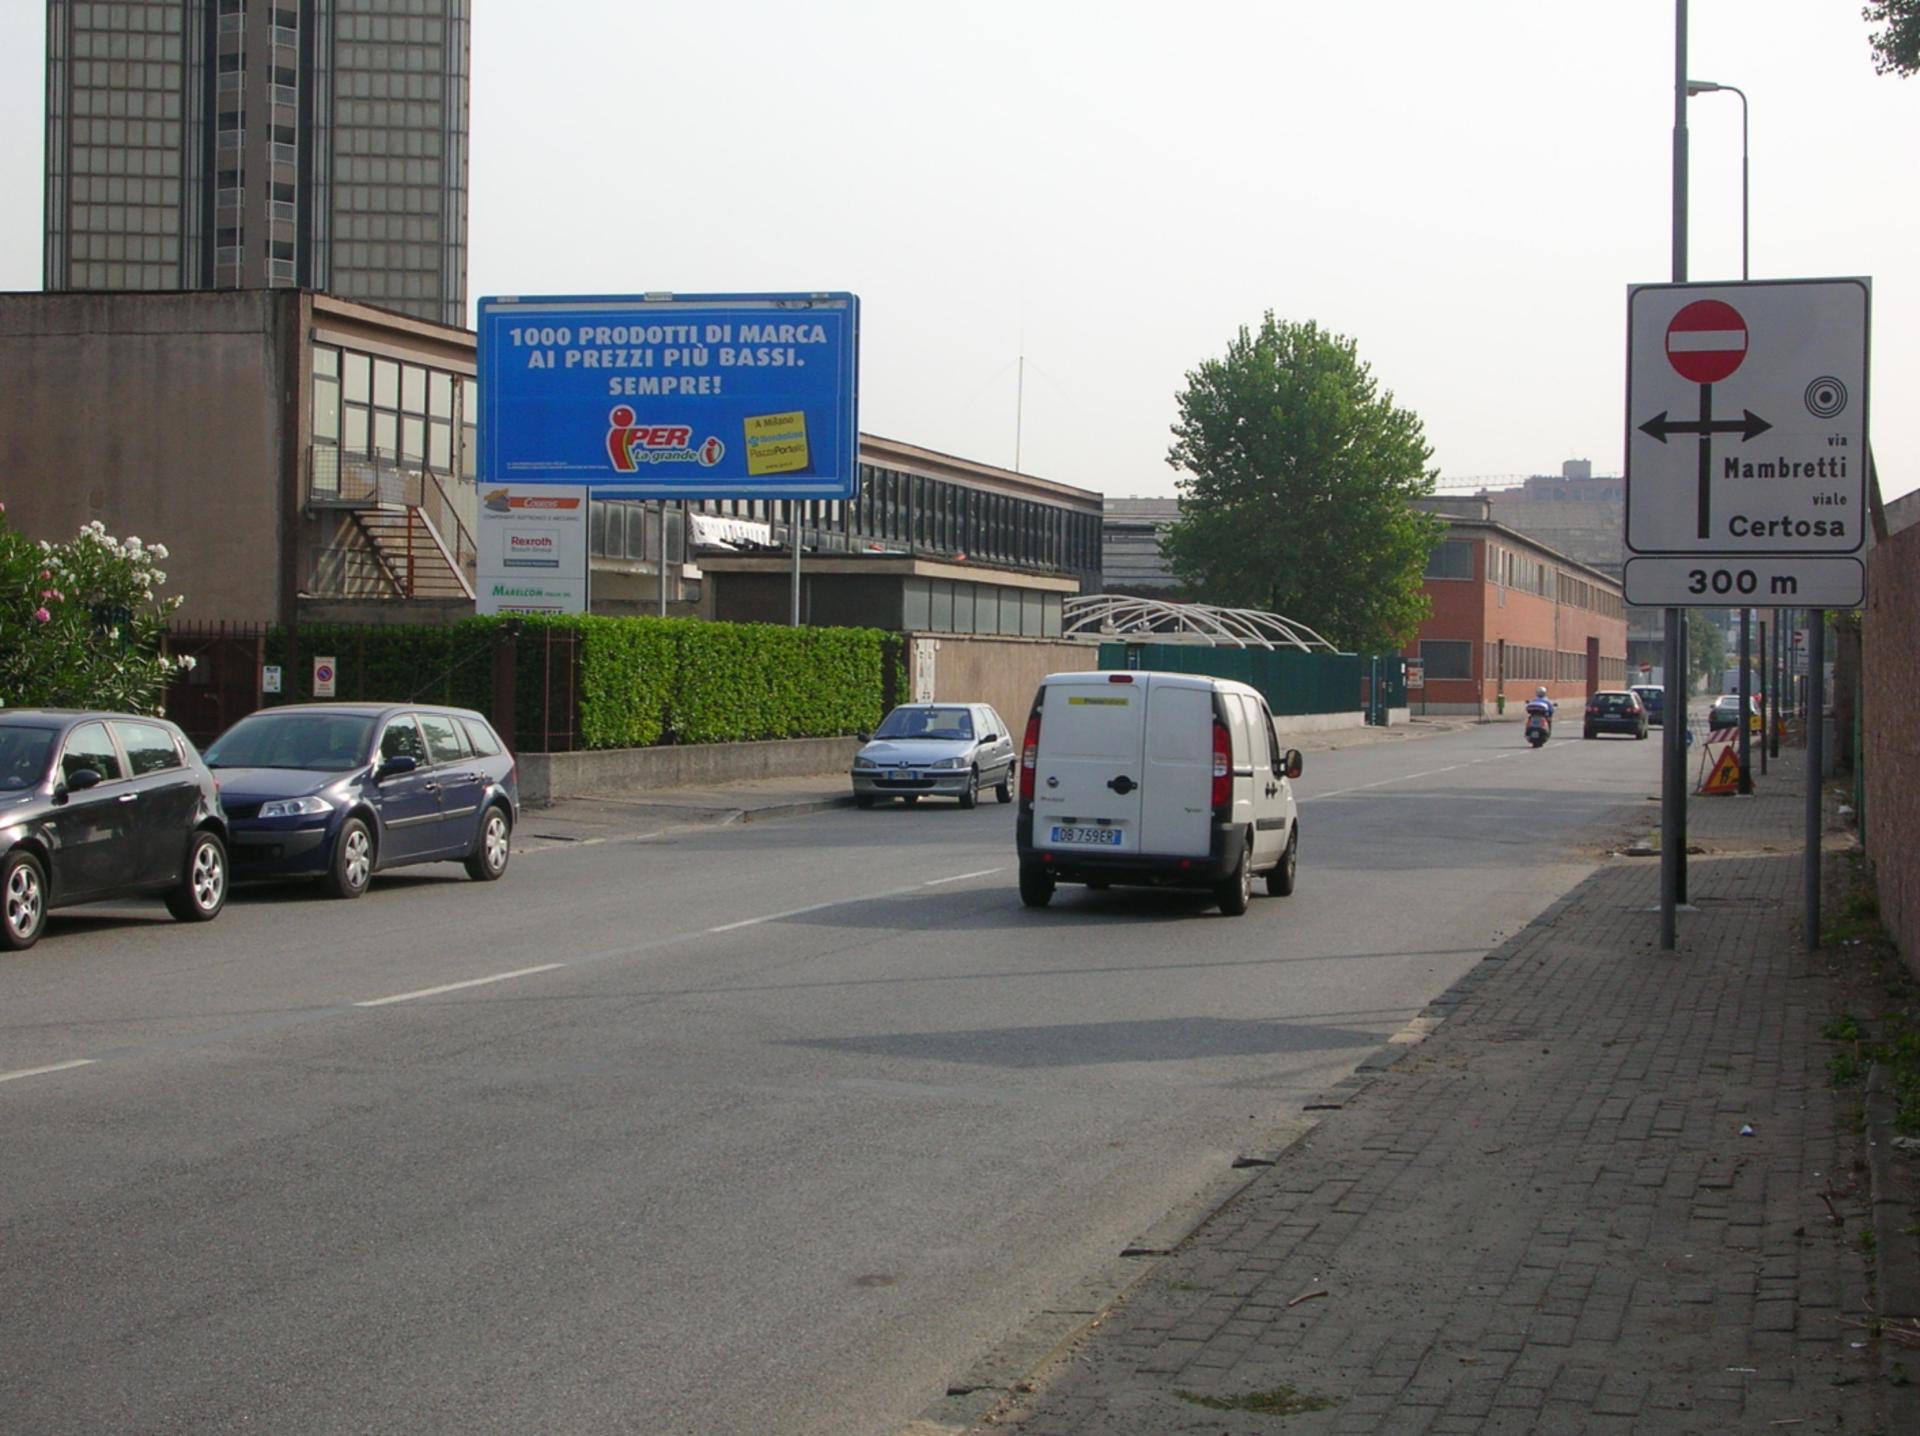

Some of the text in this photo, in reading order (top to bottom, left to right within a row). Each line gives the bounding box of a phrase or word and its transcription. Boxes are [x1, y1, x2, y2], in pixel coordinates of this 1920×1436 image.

[509, 325, 827, 346] 1000 PRODOTTI DI MARCA
[528, 342, 805, 369] AI PREZZI PIÙ BASSI.
[609, 376, 722, 396] SEMPRE!
[1827, 434, 1848, 447] via
[650, 449, 697, 463] grande
[1724, 456, 1847, 479] Mambretti
[1812, 493, 1848, 506] viale
[1729, 514, 1845, 538] Certosa
[511, 536, 552, 546] Rexroth
[1688, 569, 1798, 595] 300 m
